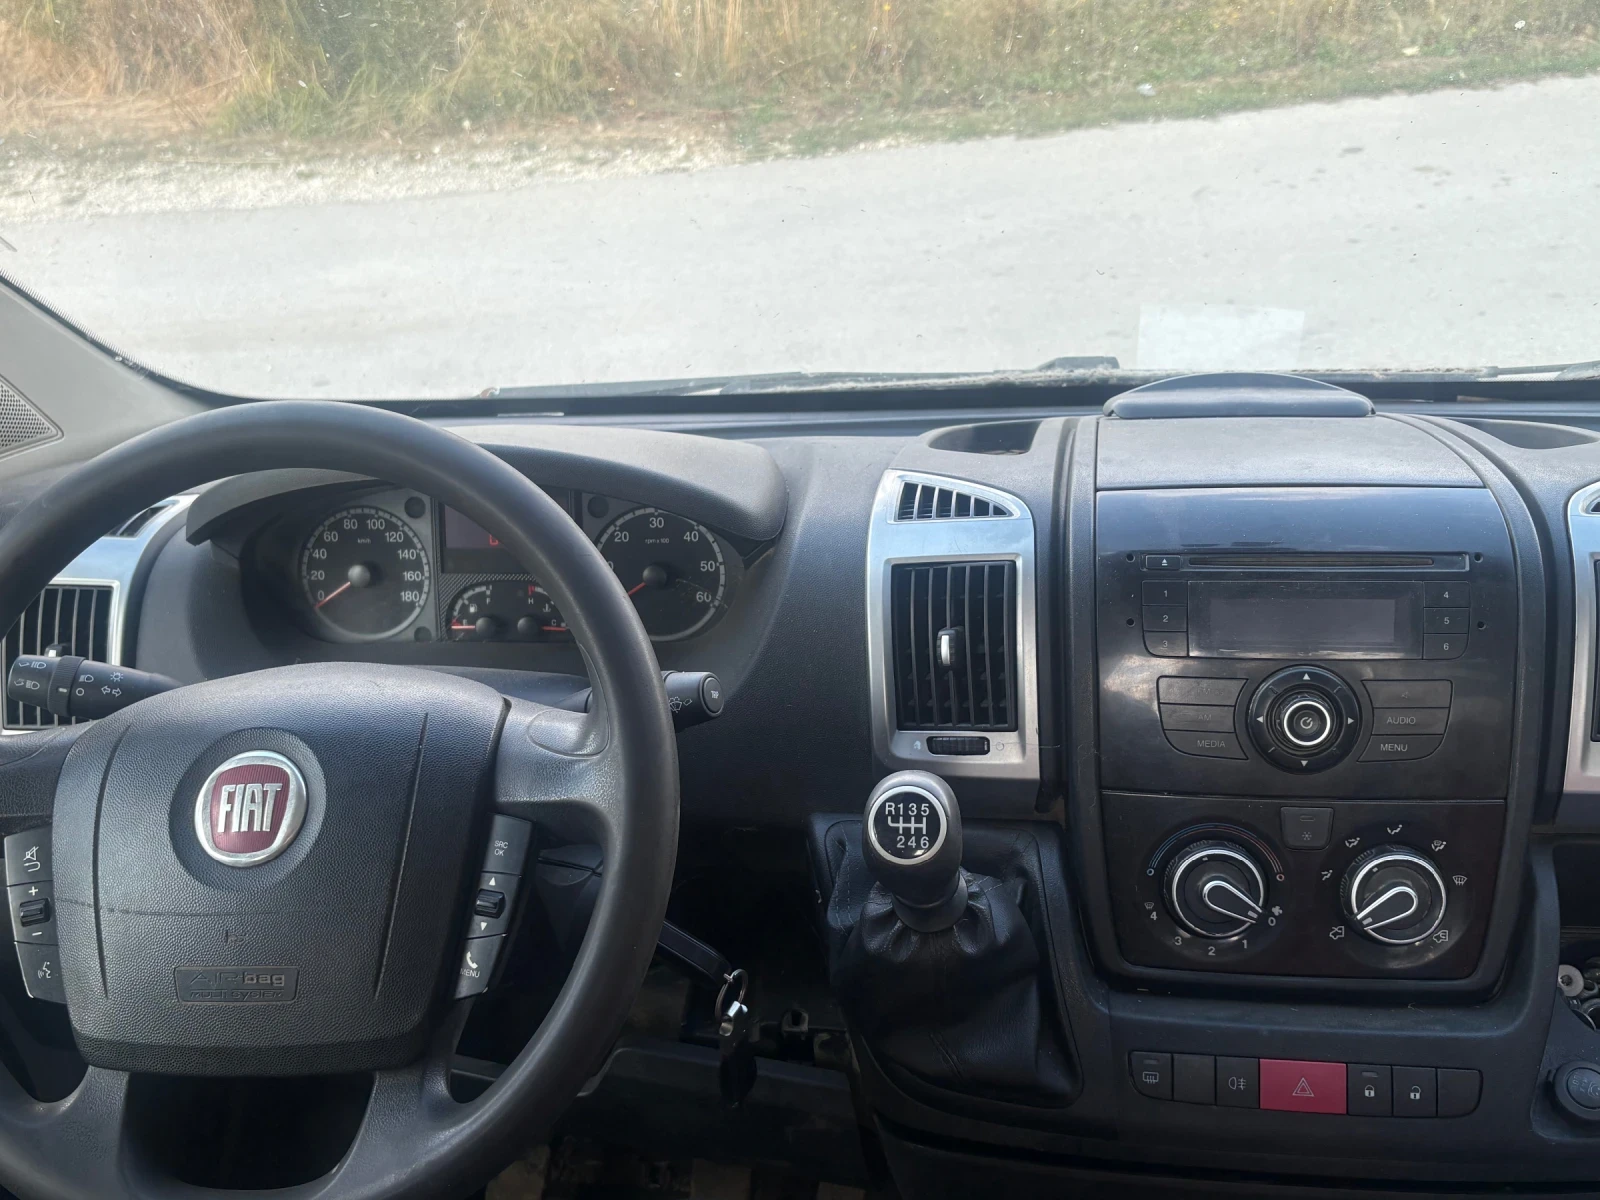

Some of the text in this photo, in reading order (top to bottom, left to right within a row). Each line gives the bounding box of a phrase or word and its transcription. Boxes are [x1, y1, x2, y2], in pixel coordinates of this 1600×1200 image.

[344, 519, 358, 529] 80
[366, 519, 385, 530] 100
[649, 517, 664, 528] 30
[324, 532, 338, 542] 60
[385, 532, 404, 542] 120
[614, 531, 629, 542] 20
[684, 531, 699, 542] 40
[312, 548, 327, 559] 40
[398, 549, 416, 560] 140
[700, 561, 715, 572] 50
[311, 570, 325, 580] 20
[403, 571, 421, 581] 160
[318, 590, 324, 600] 0
[400, 591, 419, 601] 180
[696, 591, 711, 602] 60
[1386, 716, 1416, 725] AUDIO
[1197, 740, 1226, 748] MEDIA
[217, 783, 283, 833] FIAT
[885, 802, 929, 816] R 1 3 5
[494, 840, 509, 849] SRC
[896, 836, 929, 849] 2 4 6
[1150, 911, 1157, 920] 4
[1268, 917, 1276, 926] 0
[1174, 936, 1182, 946] 3
[1242, 940, 1247, 949] 1
[1208, 946, 1216, 956] 2
[460, 967, 480, 978] MENU
